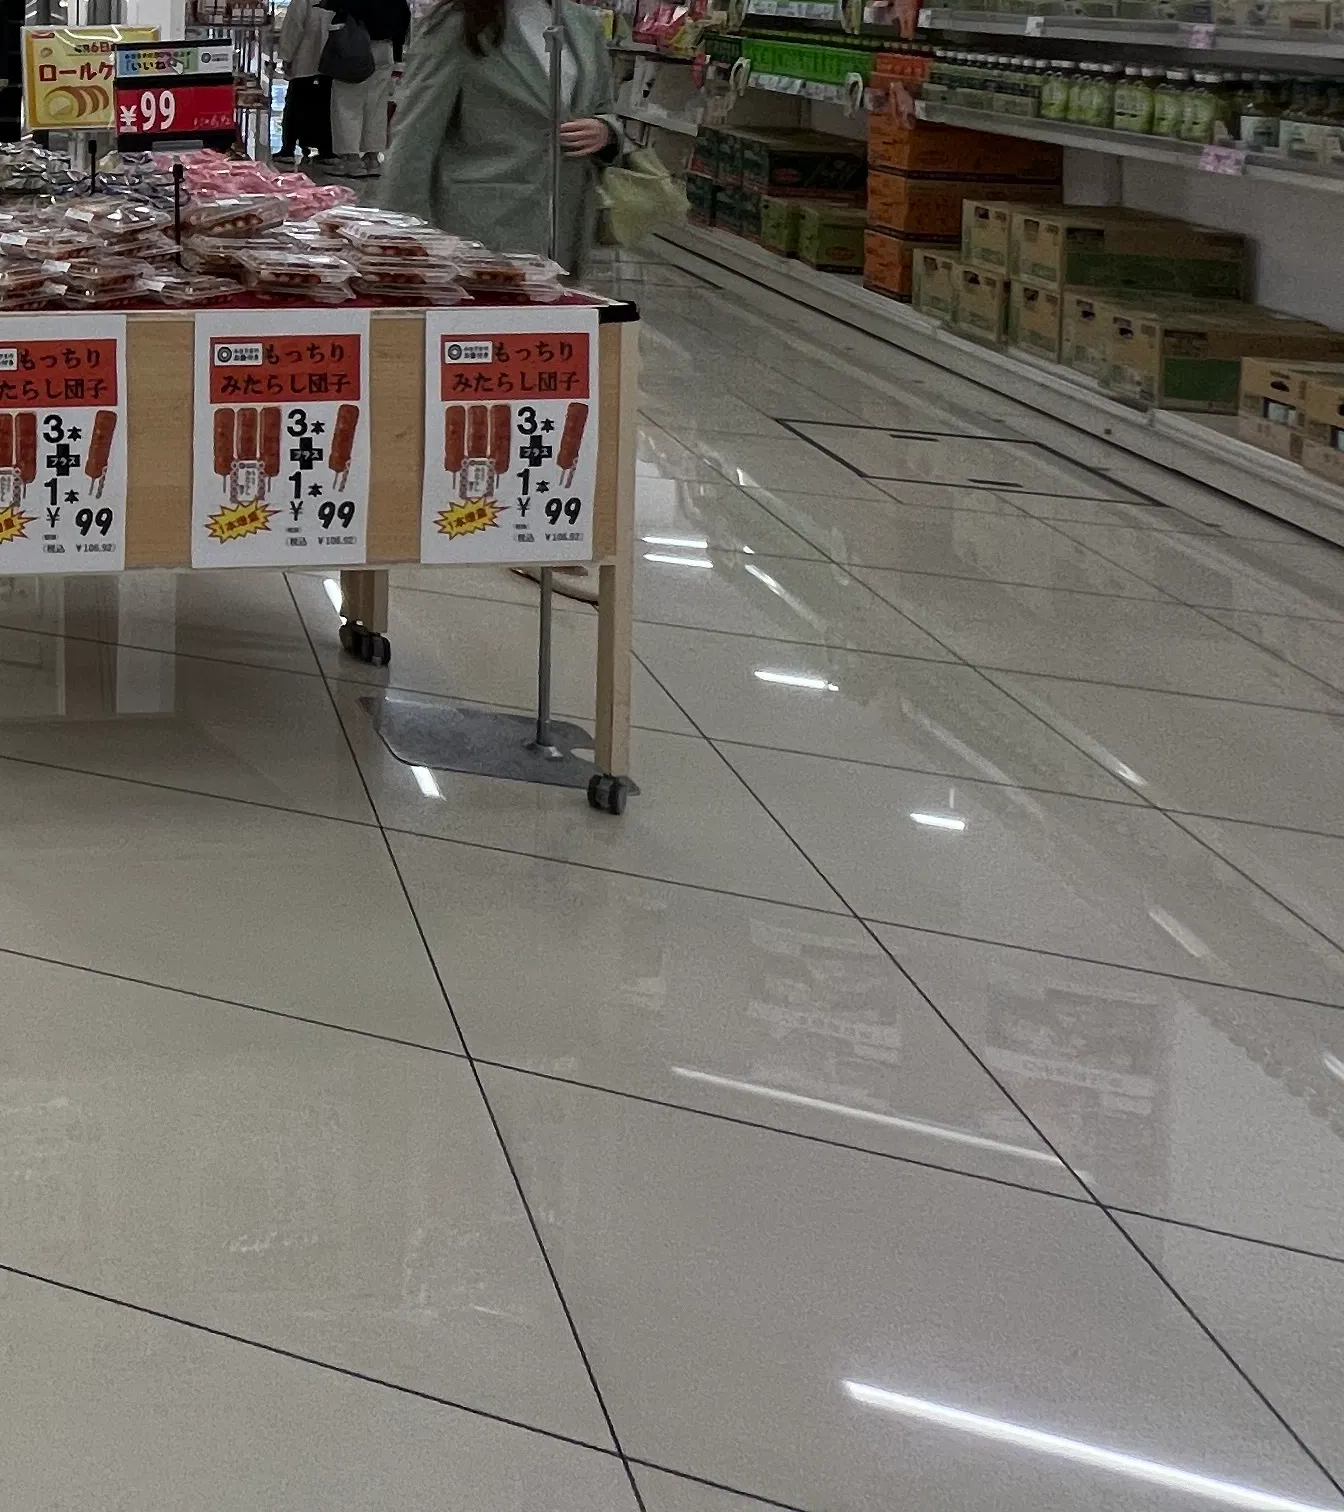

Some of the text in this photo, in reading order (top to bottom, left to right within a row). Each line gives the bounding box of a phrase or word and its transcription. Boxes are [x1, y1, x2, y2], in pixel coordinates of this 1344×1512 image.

[120, 90, 175, 132] ¥99
[19, 348, 100, 370] もっちり
[265, 342, 344, 364] もっちり
[495, 341, 573, 363] もっちり
[221, 373, 351, 395] みたらし団子
[452, 371, 579, 393] みたらし団子
[43, 414, 82, 443] 3本
[287, 408, 325, 437] 3本
[517, 406, 554, 435] 3本
[44, 478, 79, 505] 1本
[289, 471, 323, 499] 1本
[516, 468, 550, 496] 1本
